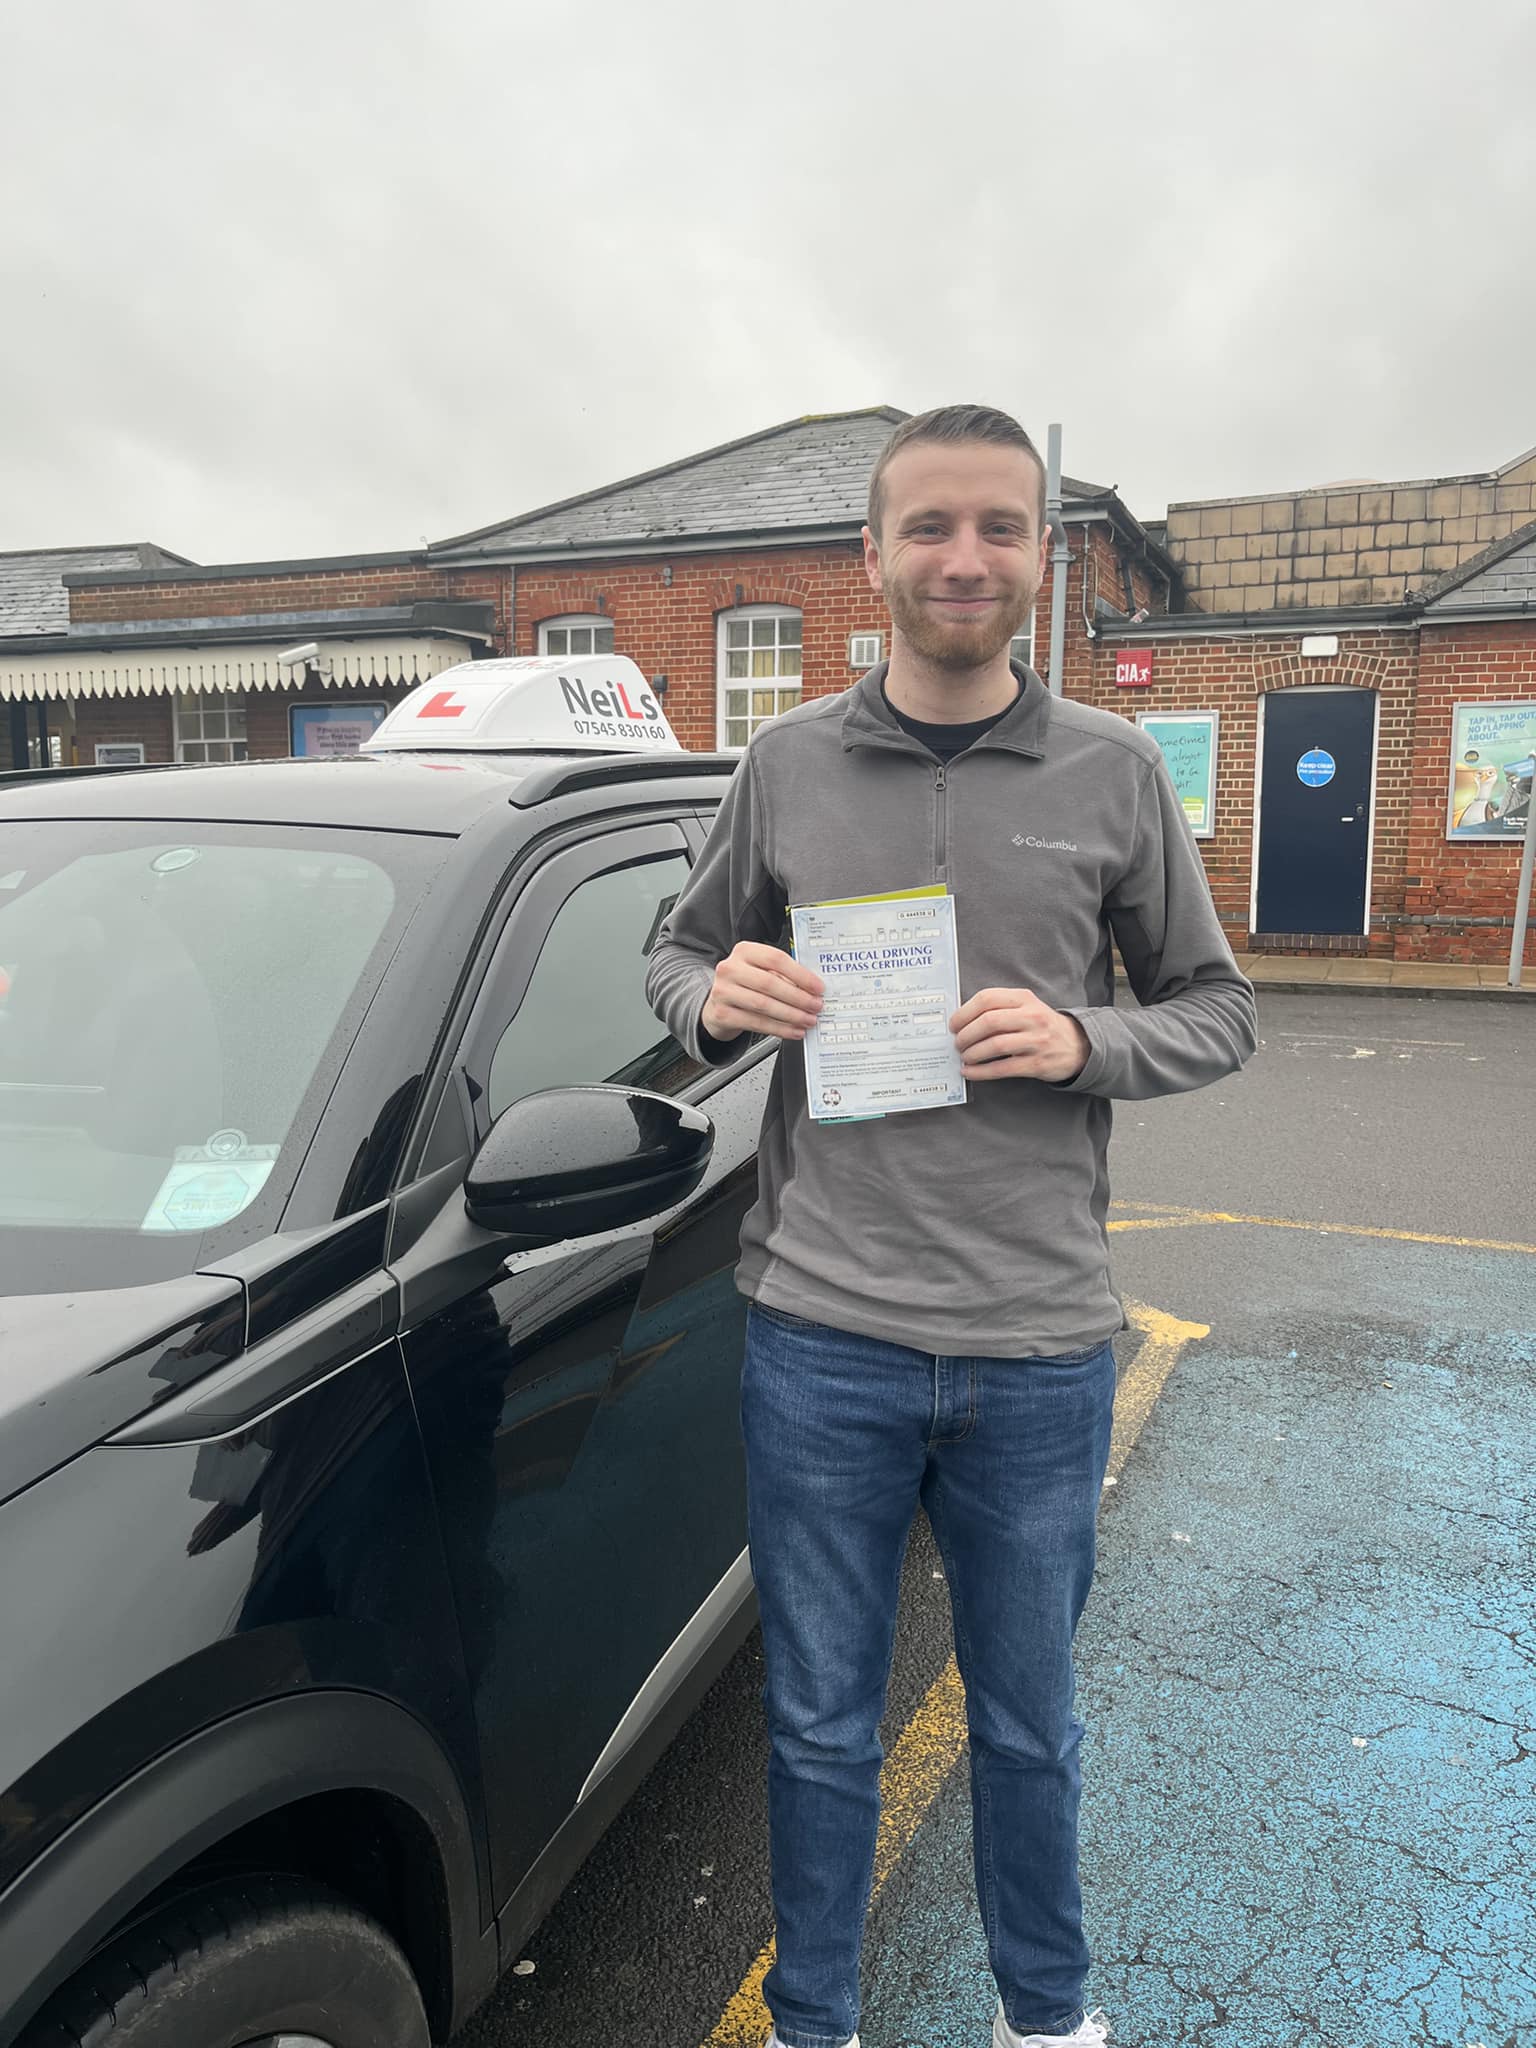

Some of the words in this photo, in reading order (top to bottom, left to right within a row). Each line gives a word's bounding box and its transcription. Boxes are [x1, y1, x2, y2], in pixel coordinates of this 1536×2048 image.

[1116, 663, 1138, 682] CIA
[558, 676, 658, 721] NeiLs
[1468, 725, 1480, 734] NO
[1483, 720, 1525, 732] FLAPPING
[1469, 716, 1485, 725] TAP
[1500, 713, 1515, 722] TAP
[574, 720, 616, 737] 07545
[619, 725, 666, 740] 830160
[1025, 836, 1078, 852] Columbia
[819, 950, 879, 964] PRACTICAL
[882, 945, 933, 960] DRIVING
[821, 963, 843, 973] TEST
[845, 962, 869, 972] PASS
[871, 955, 934, 970] CERTIFICATE
